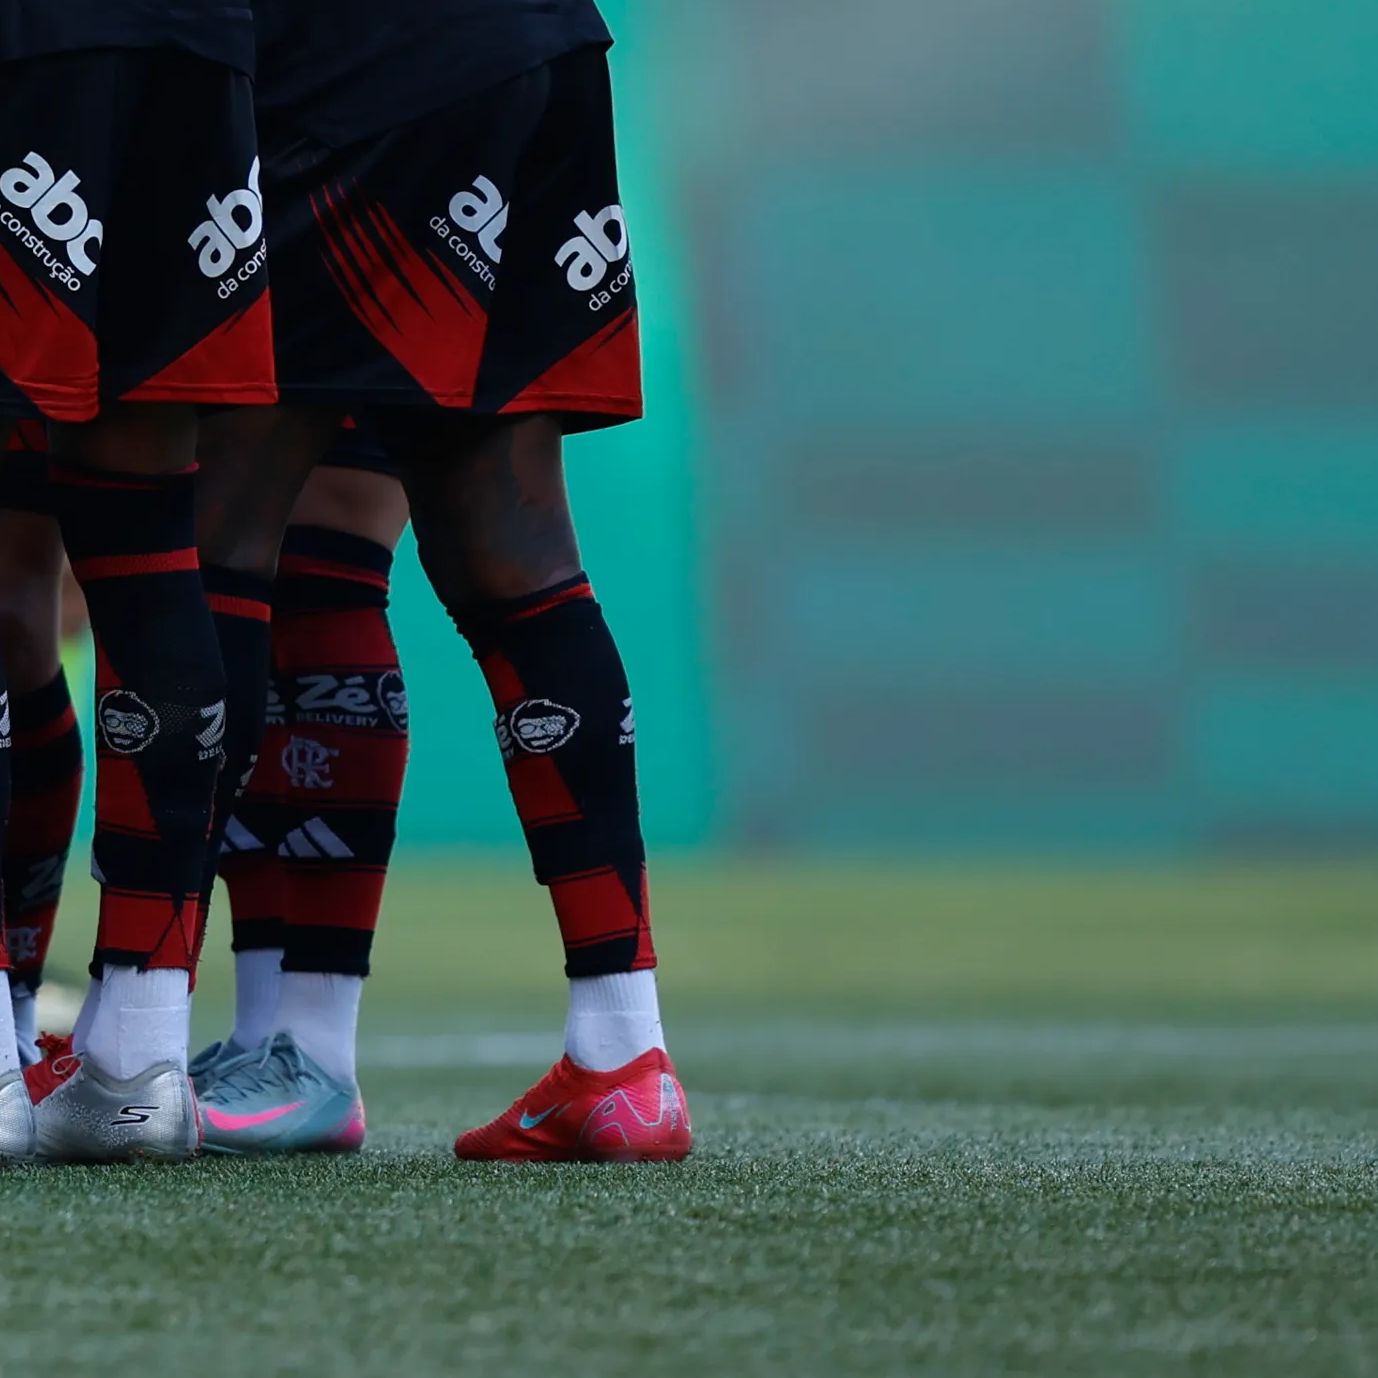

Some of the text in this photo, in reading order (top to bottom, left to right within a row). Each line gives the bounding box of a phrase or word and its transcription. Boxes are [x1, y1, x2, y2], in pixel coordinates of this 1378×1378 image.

[428, 215, 451, 239] da
[0, 210, 82, 292] construção
[553, 203, 630, 292] ab
[216, 277, 239, 300] da
[588, 287, 612, 312] da
